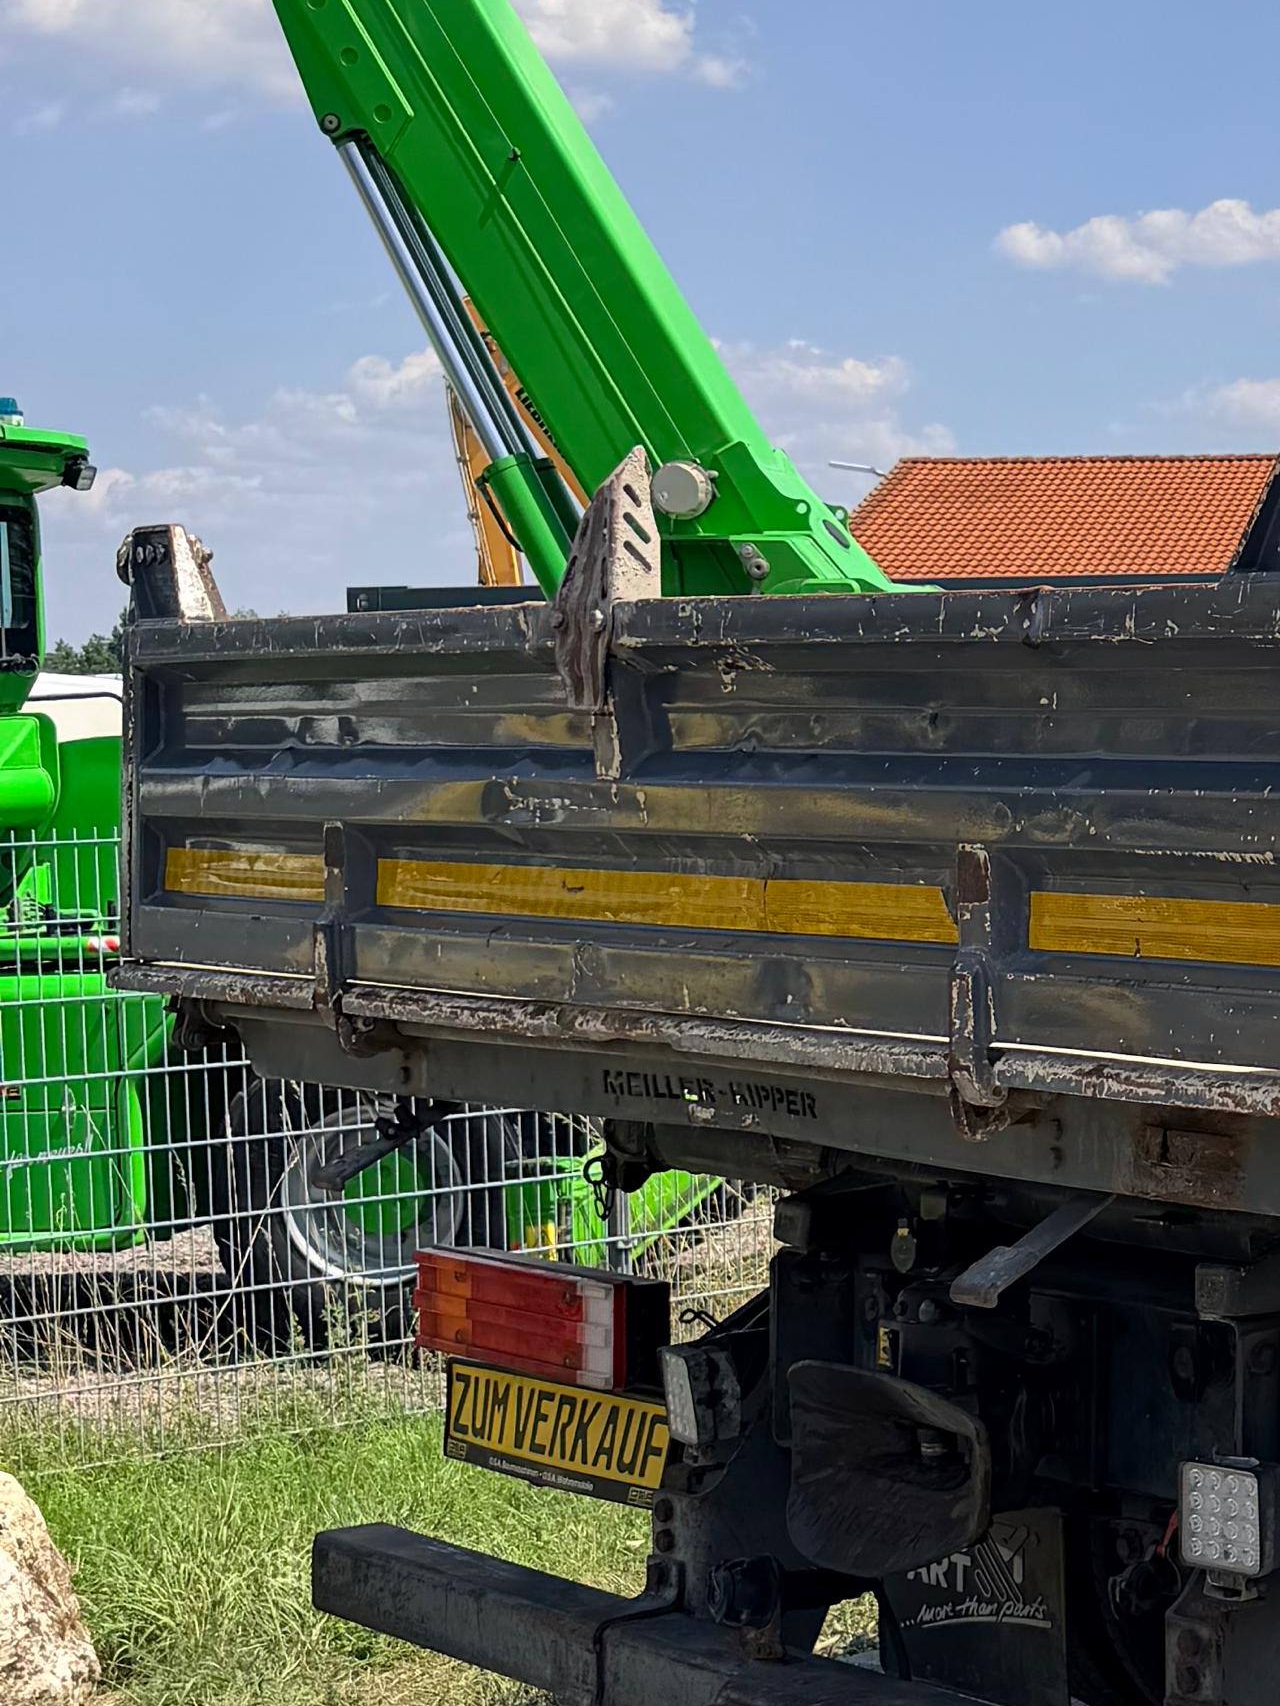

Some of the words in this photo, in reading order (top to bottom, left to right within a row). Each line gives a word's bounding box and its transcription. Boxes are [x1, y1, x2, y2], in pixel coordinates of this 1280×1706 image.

[452, 1372, 511, 1445] ZUM
[514, 1385, 669, 1479] VERKAUF
[954, 1595, 998, 1617] than
[996, 1595, 1048, 1623] parts
